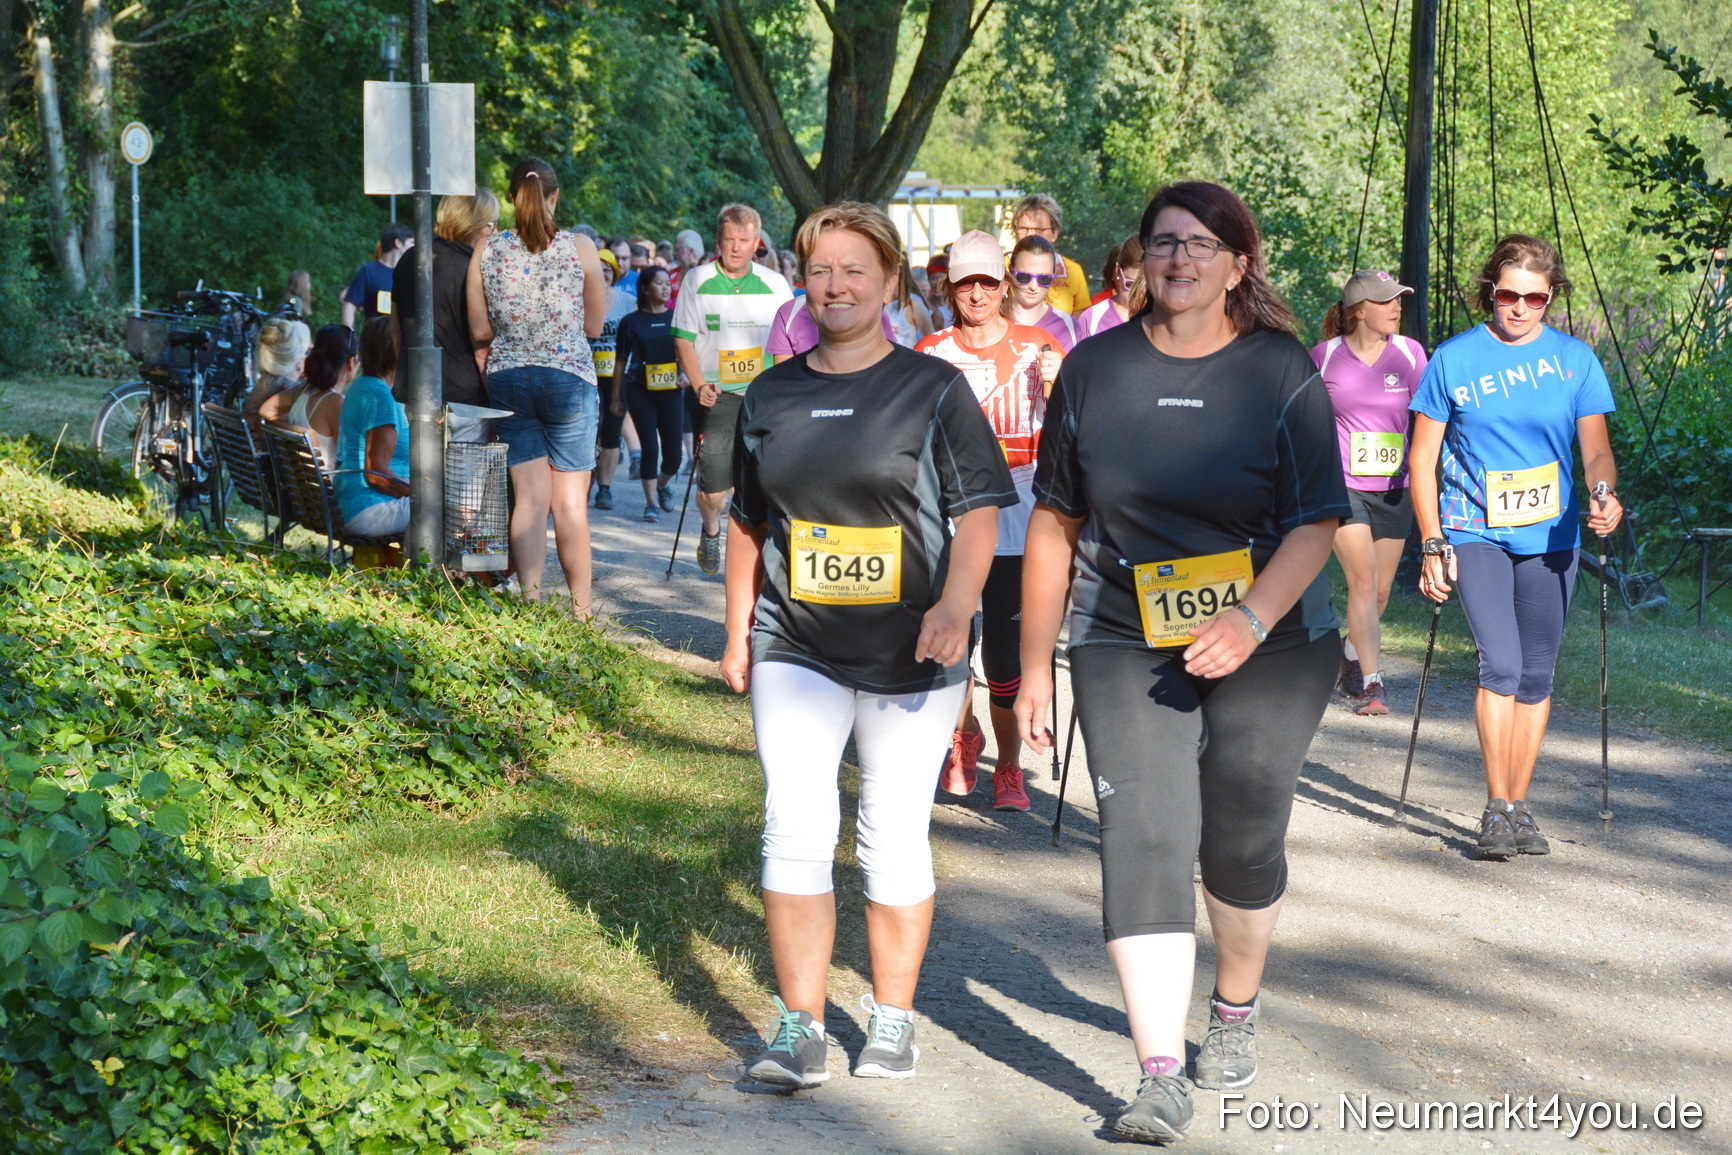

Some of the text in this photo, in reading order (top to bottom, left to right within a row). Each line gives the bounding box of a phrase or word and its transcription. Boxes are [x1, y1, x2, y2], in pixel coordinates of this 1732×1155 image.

[730, 359, 755, 373] 105
[650, 372, 675, 383] 1705
[1498, 483, 1551, 511] 1737
[805, 535, 840, 546] firmenlauf
[804, 552, 885, 583] 1649
[1151, 572, 1190, 584] firmenlauf
[818, 582, 850, 591] Germes
[1155, 583, 1241, 622] 1694
[1163, 622, 1197, 632] Segerer
[1152, 631, 1172, 639] Regens
